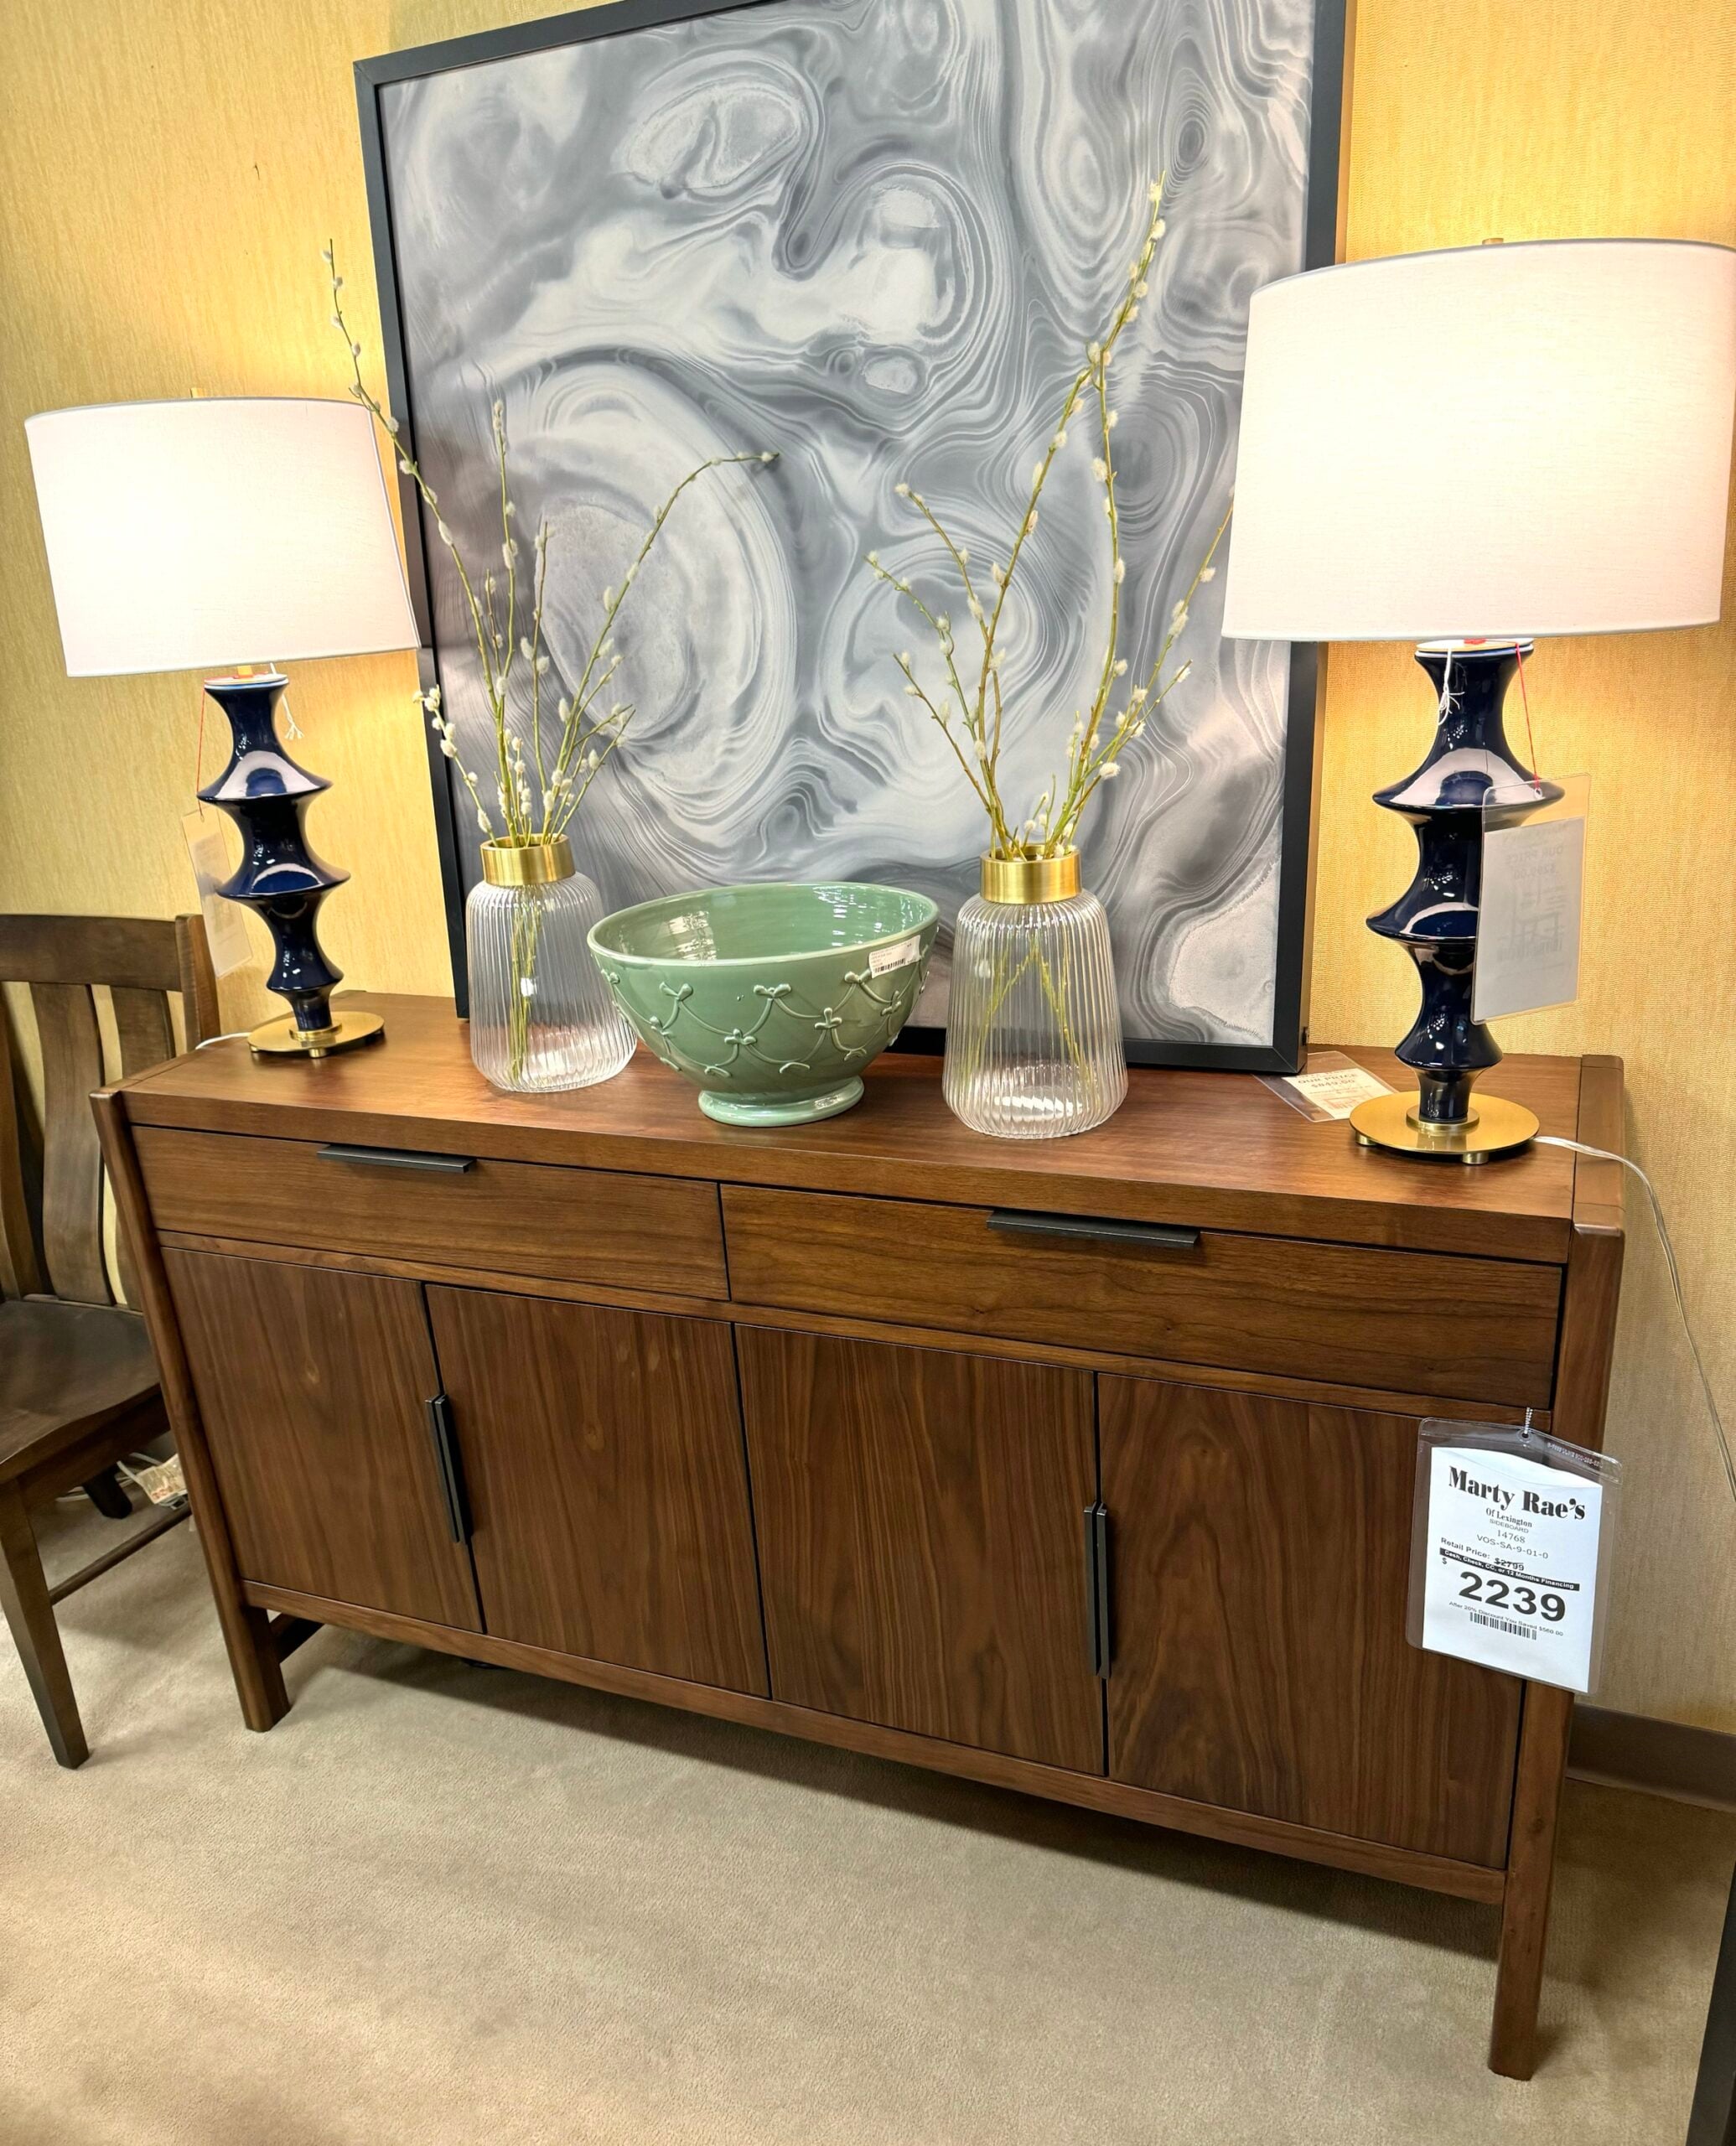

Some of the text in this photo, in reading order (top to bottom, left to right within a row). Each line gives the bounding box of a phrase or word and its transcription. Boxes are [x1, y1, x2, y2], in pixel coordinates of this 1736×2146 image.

[1448, 1465, 1585, 1520] Marty Rae's
[1486, 1507, 1532, 1527] Of Lexington
[1490, 1518, 1529, 1533] SIDEBOARD
[1477, 1534, 1548, 1559] VOS-SA-9-01-0
[1498, 1529, 1526, 1543] 14768
[1441, 1537, 1524, 1571] Retail Price: $2799
[1516, 1572, 1539, 1582] Months
[1541, 1578, 1574, 1589] Financing
[1459, 1571, 1566, 1621] 2239
[1464, 1604, 1477, 1613] 20%
[1479, 1609, 1504, 1620] Discount
[1519, 1620, 1537, 1629] Saved
